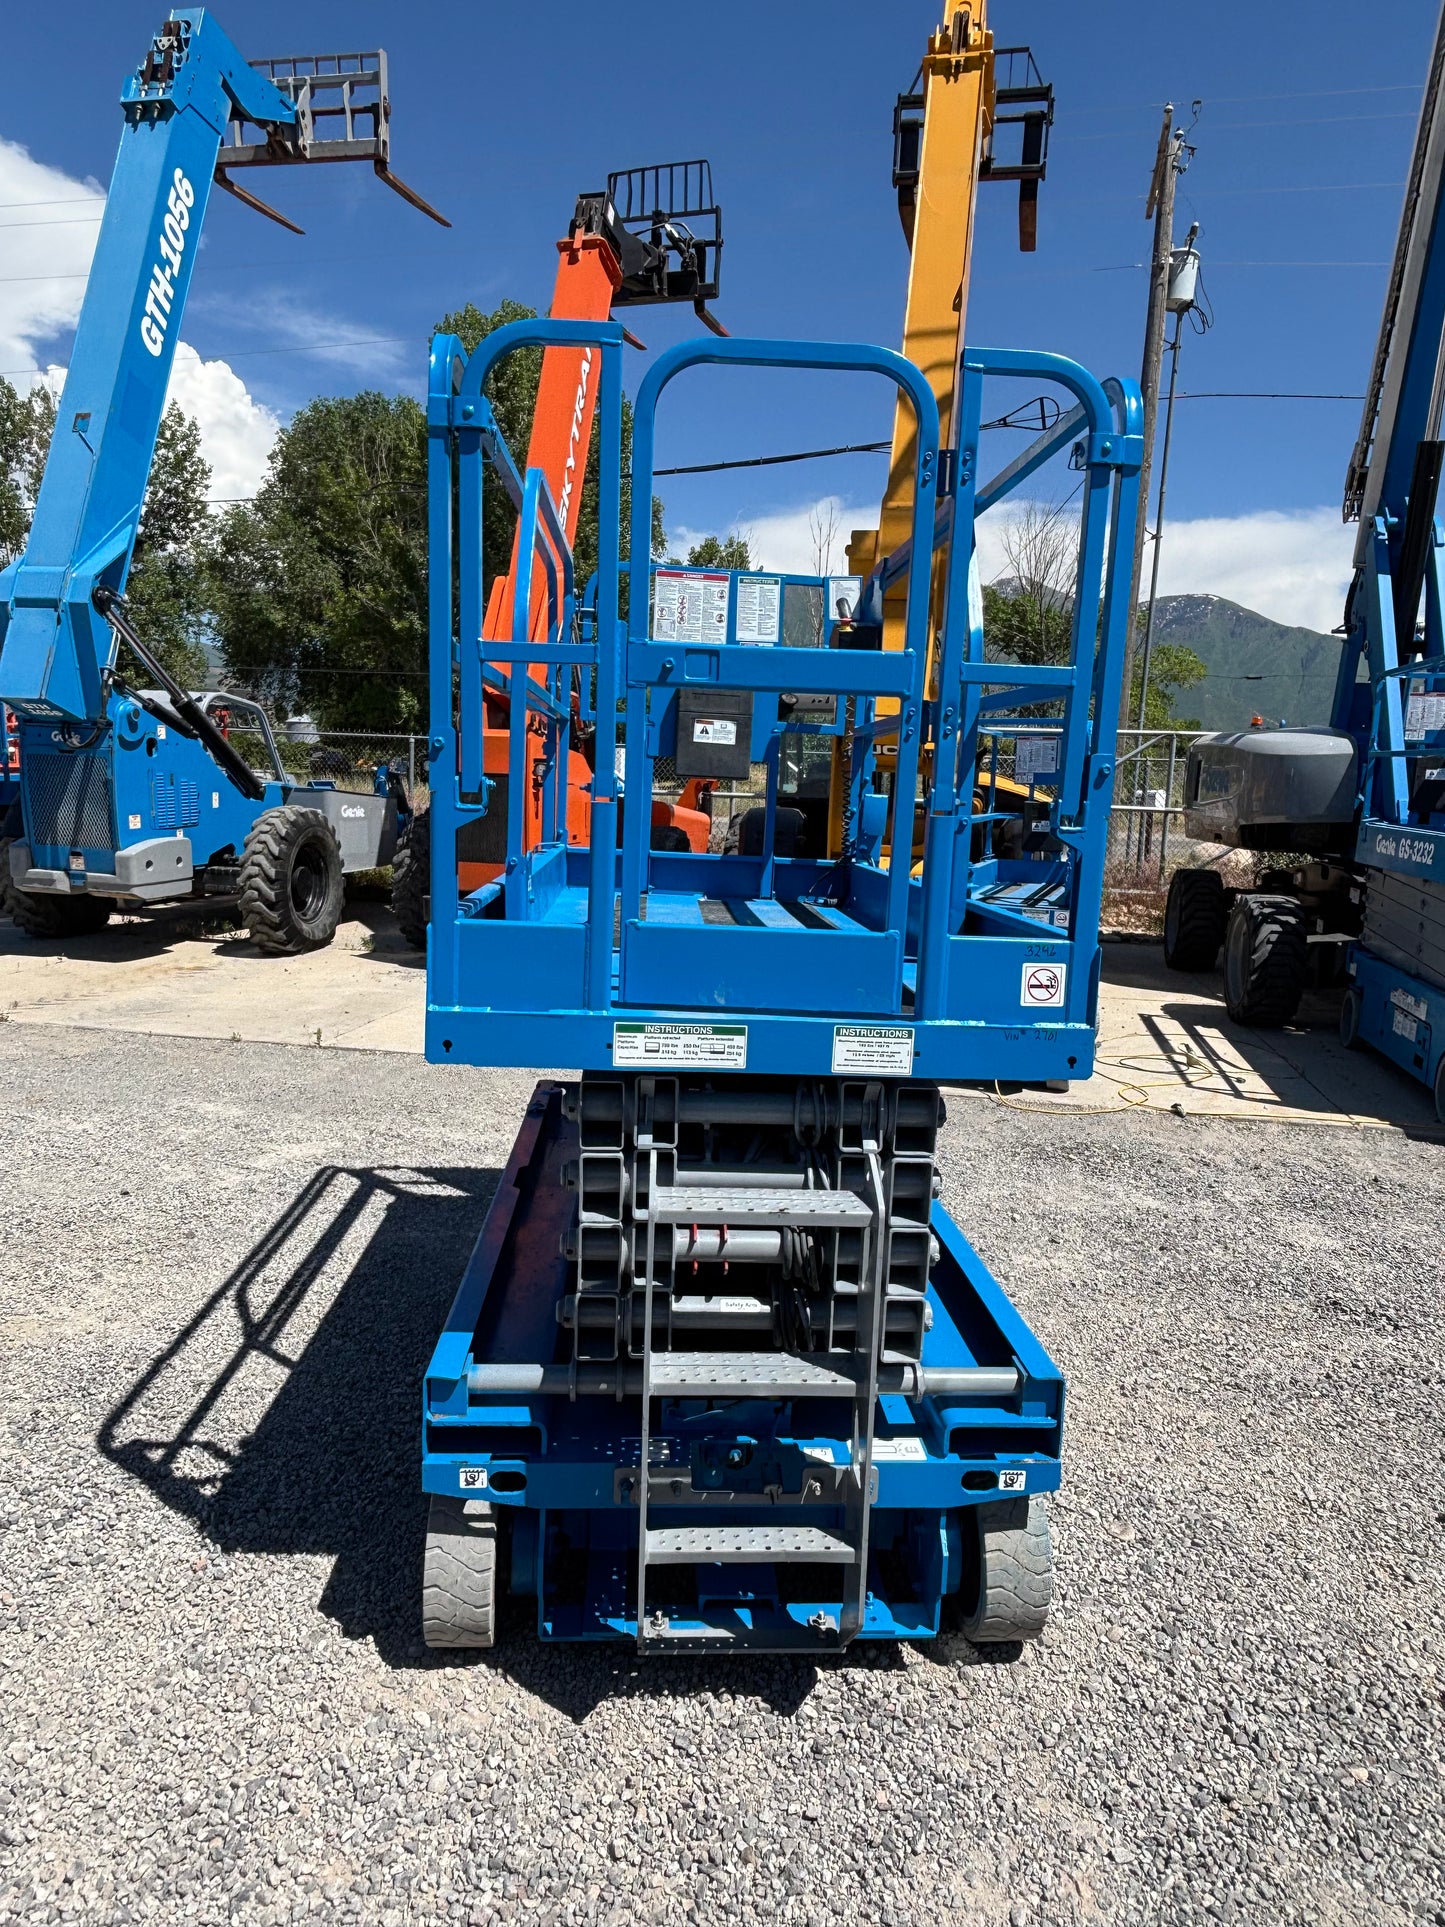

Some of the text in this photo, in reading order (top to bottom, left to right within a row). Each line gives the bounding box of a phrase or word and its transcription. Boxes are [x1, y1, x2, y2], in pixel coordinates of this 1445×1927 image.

[140, 167, 195, 357] GTH-1056
[872, 744, 898, 756] JC
[341, 804, 366, 818] Genie
[1376, 833, 1436, 866] Genie GS-3232
[644, 1024, 713, 1035] INSTRUCTIONS
[839, 1028, 909, 1038] INSTRUCTIONS
